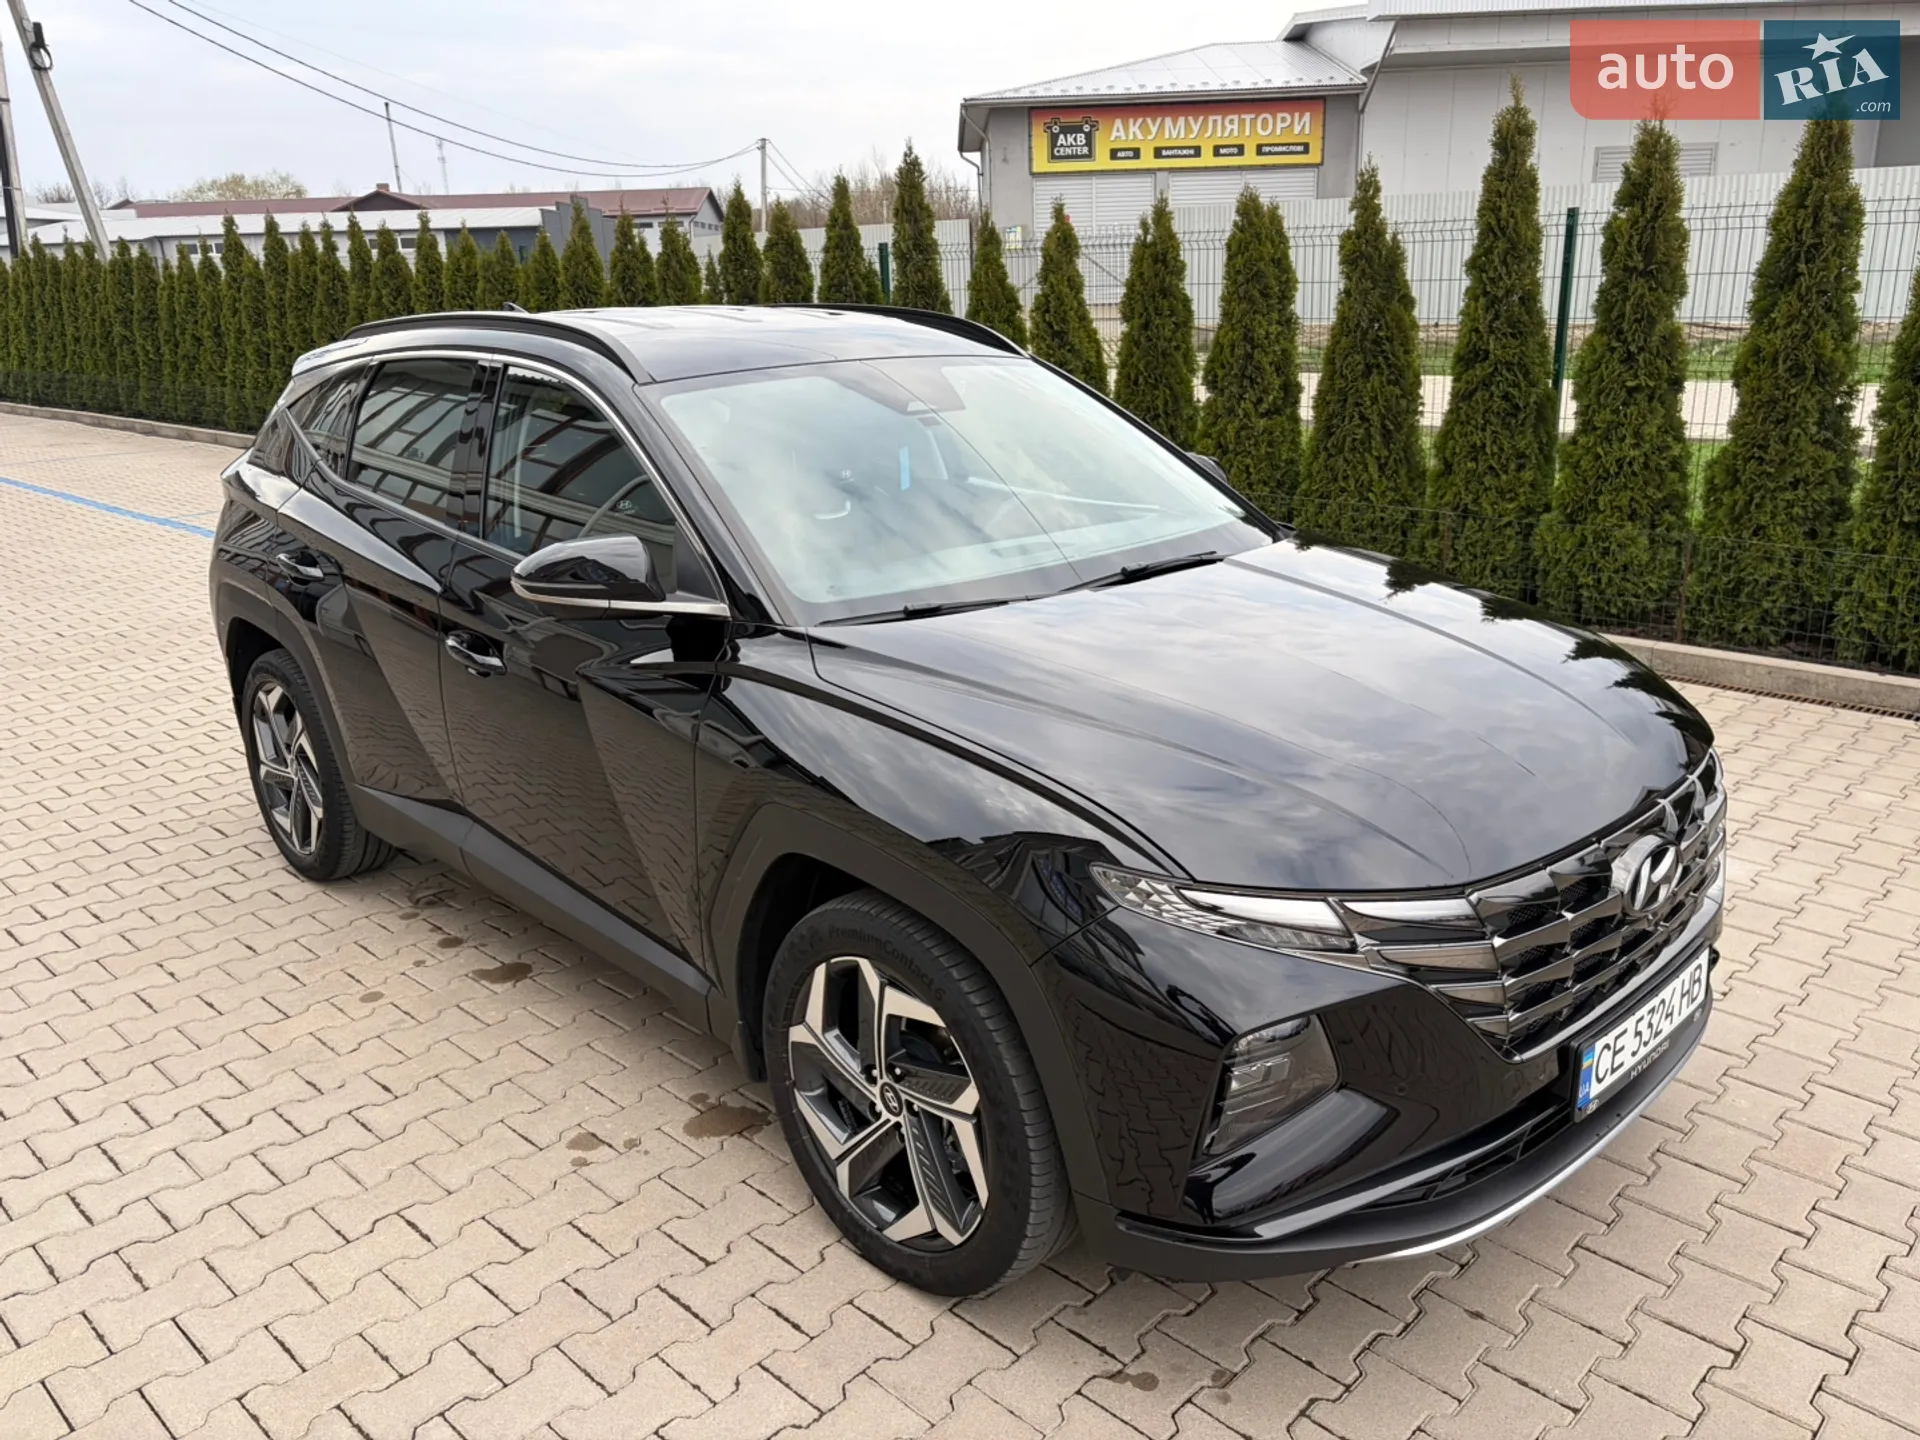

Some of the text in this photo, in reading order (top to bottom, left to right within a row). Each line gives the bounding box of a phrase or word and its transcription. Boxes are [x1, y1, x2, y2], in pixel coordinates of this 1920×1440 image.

[1110, 111, 1311, 141] АКУМУЛЯТОРИ
[1053, 146, 1089, 156] CENTER
[1116, 150, 1134, 158] АВТО
[1219, 147, 1239, 156] МОТО
[828, 924, 946, 1002] PremiumContact 6
[1595, 963, 1702, 1084] CE 5324 HB
[1630, 1039, 1670, 1080] HYUNDAI
[1579, 1081, 1590, 1098] UA
